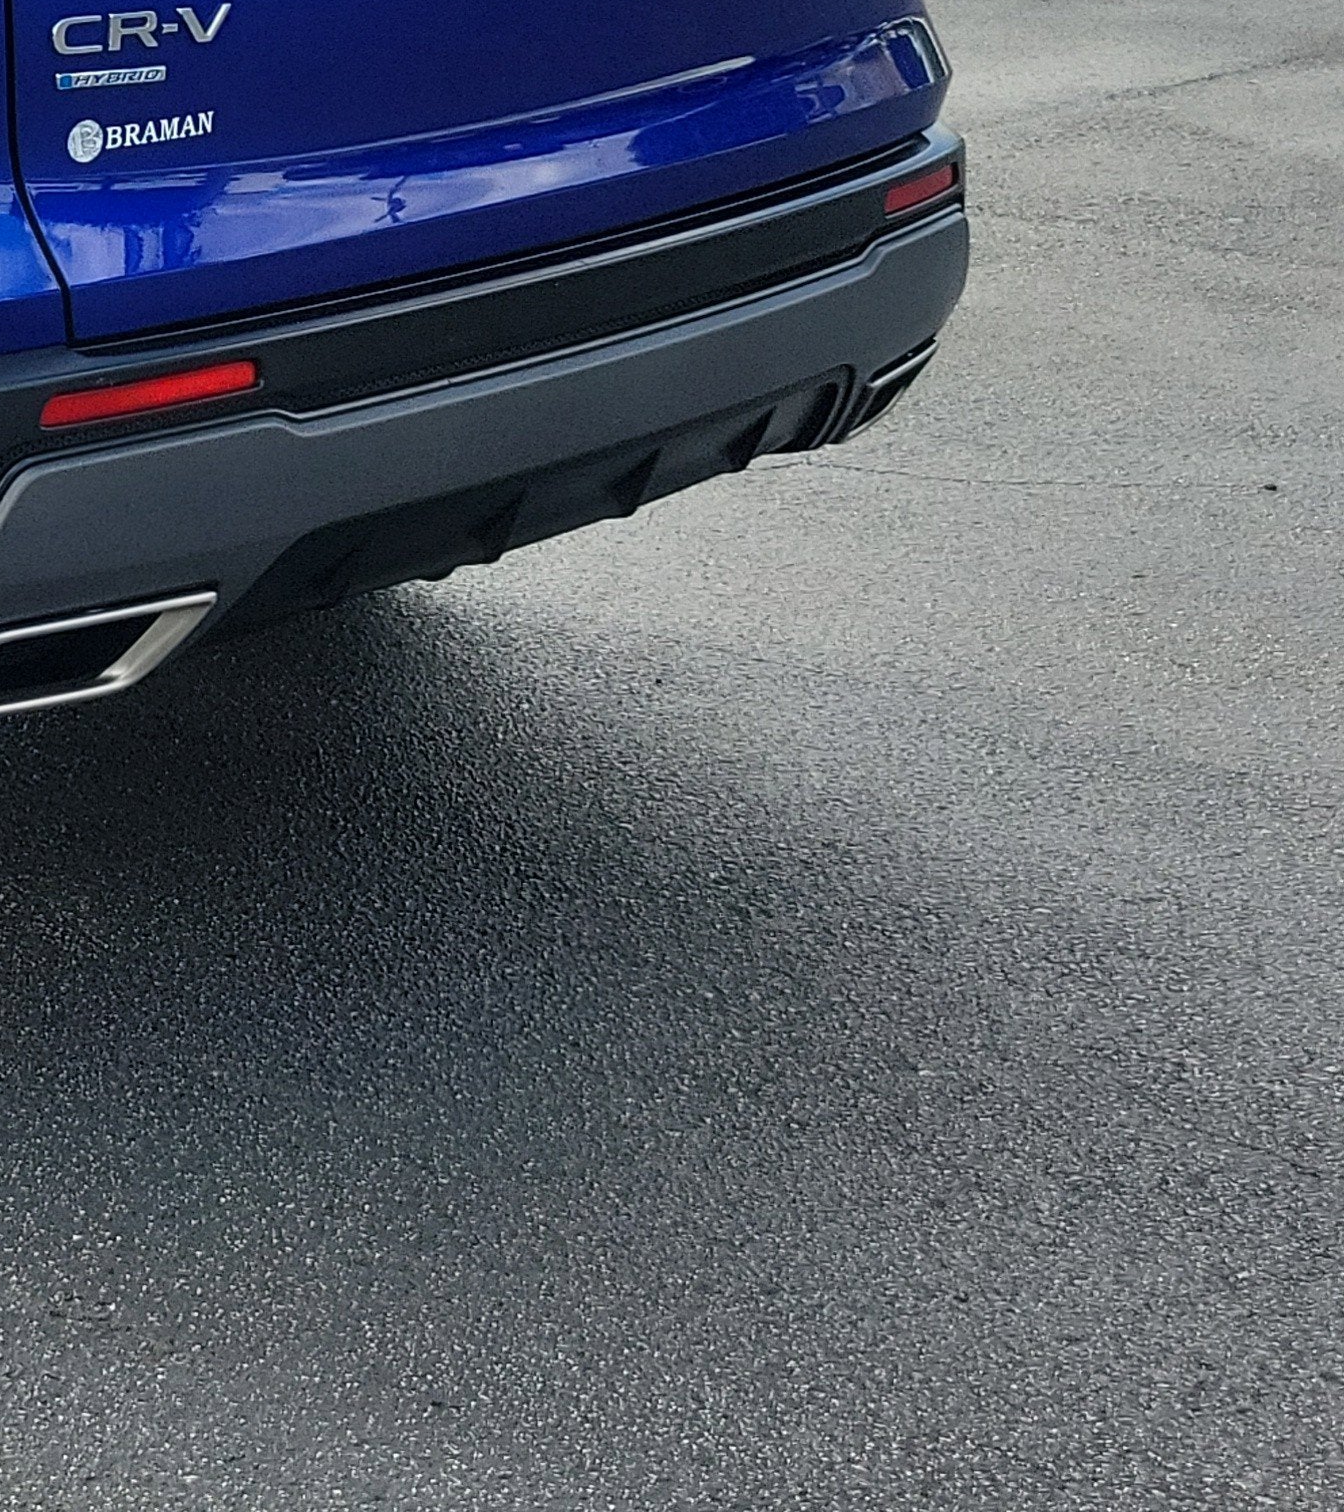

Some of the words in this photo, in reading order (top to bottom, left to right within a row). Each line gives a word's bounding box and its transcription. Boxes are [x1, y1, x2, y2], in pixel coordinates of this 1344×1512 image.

[52, 3, 232, 55] CR-V
[74, 69, 160, 87] HYBRID
[105, 110, 214, 149] BRAMAN
